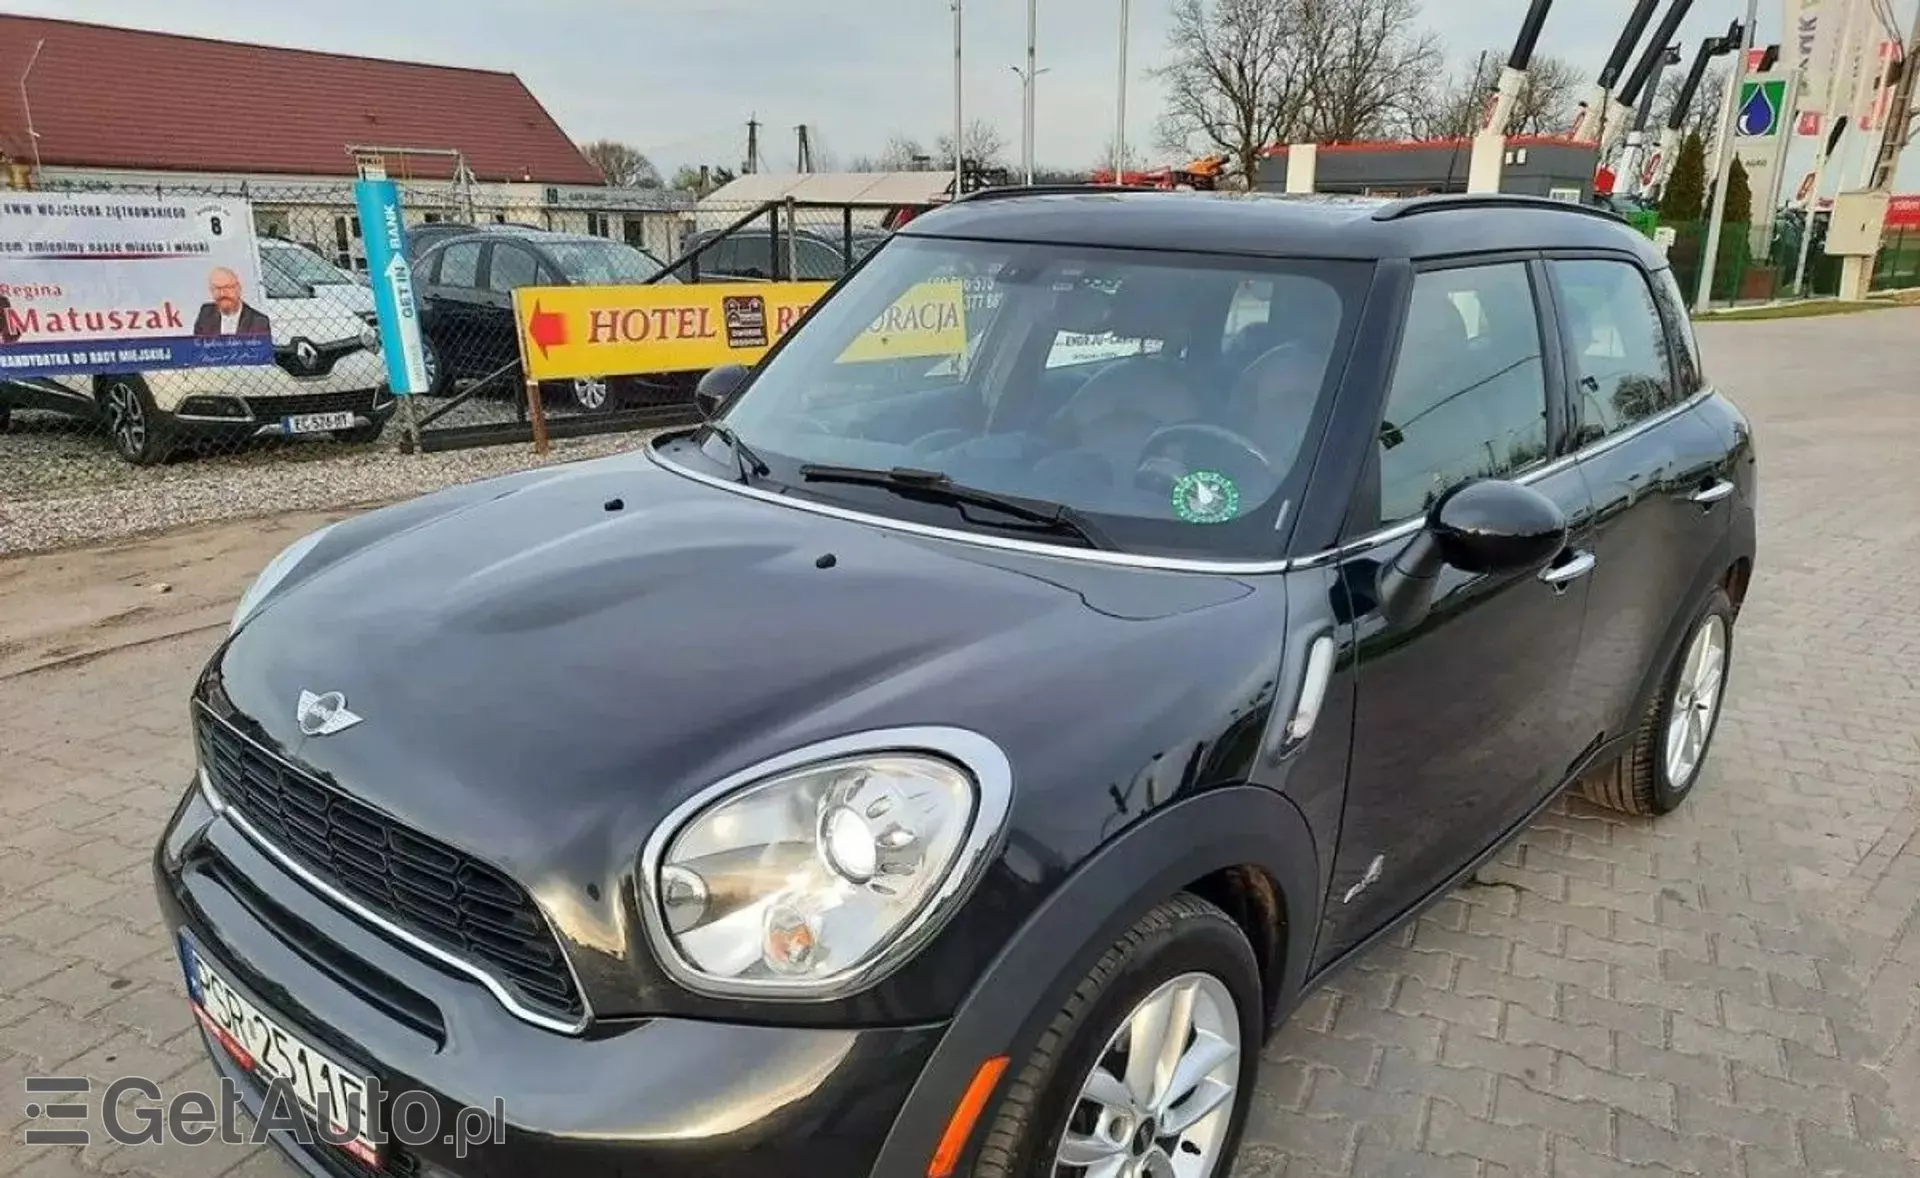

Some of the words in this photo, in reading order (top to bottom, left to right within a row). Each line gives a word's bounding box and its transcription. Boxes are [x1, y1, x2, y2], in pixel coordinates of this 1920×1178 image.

[36, 203, 101, 216] WOJCIECHA
[211, 216, 222, 235] 8
[384, 203, 402, 250] BANK
[28, 240, 84, 255] zmienimy
[87, 241, 121, 252] nasze
[124, 240, 164, 253] miasto
[0, 283, 62, 300] Regina
[7, 301, 184, 334] Matuszak
[588, 306, 716, 344] HOTEL
[72, 351, 88, 365] DO
[89, 350, 116, 365] RADY
[118, 347, 172, 363] MIEJSKIEJ
